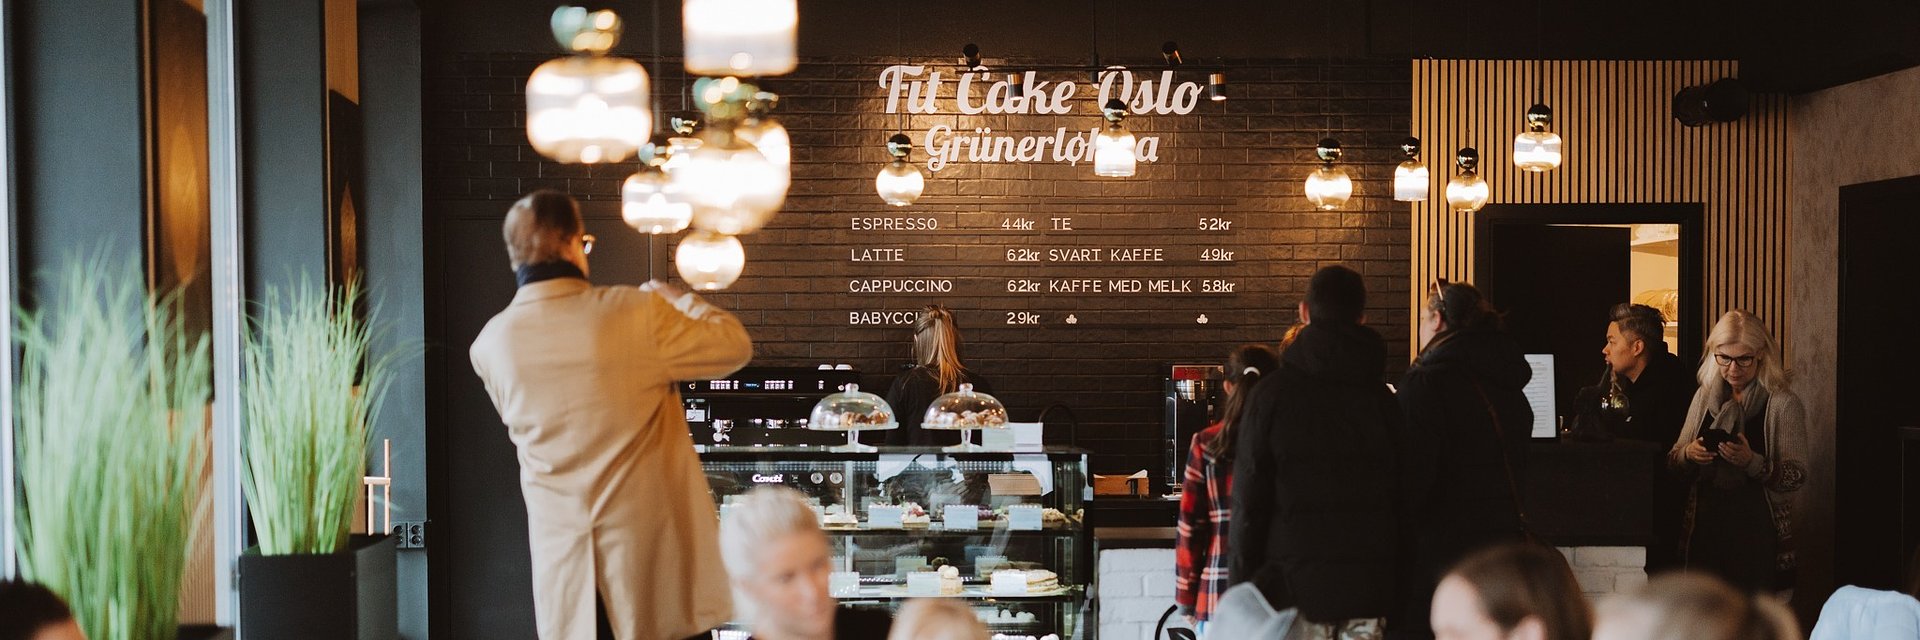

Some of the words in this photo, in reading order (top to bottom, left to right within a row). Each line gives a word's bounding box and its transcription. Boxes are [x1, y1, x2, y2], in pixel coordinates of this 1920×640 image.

[878, 65, 943, 115] Fit
[957, 65, 1076, 115] Cake
[1092, 65, 1205, 115] Oslo
[925, 124, 1160, 172] Grünerløa
[851, 217, 938, 231] ESPRESSO
[1001, 217, 1035, 231] 44kr
[1050, 217, 1073, 231] TE
[1199, 217, 1232, 231] 52kr
[851, 248, 905, 262] LATTE
[1006, 248, 1041, 262] 62kr
[1049, 248, 1102, 262] SVART
[1110, 248, 1164, 262] KAFFE
[1200, 248, 1234, 262] 49kr
[849, 279, 953, 293] CAPPUCCINO
[1007, 279, 1041, 293] 62kr
[1049, 279, 1102, 293] KAFFE
[1109, 279, 1142, 293] MED
[1148, 279, 1192, 293] MELK
[1202, 279, 1236, 293] 58kr
[849, 311, 921, 325] BABYCCI
[1006, 311, 1041, 325] 29kr
